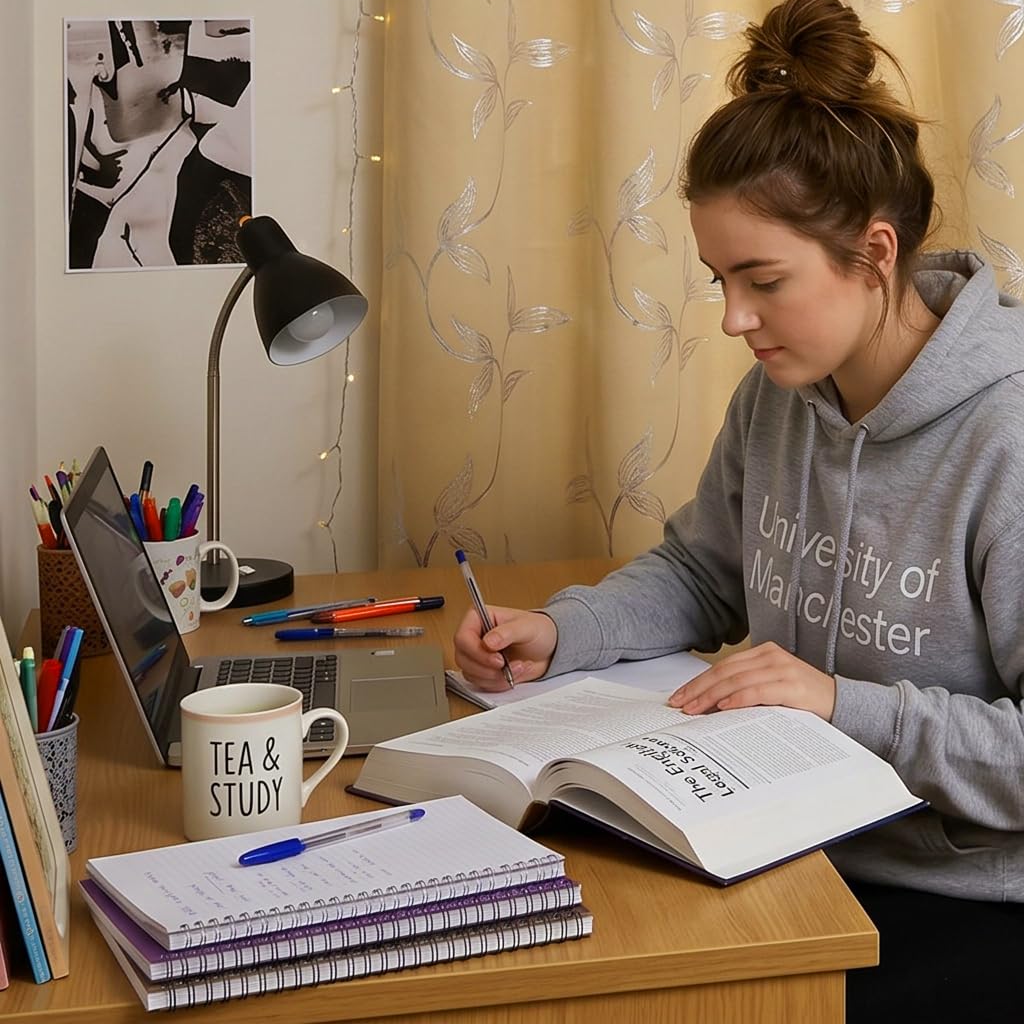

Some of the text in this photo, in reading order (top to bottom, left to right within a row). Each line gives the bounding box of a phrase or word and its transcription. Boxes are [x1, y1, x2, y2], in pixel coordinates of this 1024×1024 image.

[759, 495, 941, 603] Univesity of
[210, 736, 280, 776] TEA &
[210, 776, 283, 817] STUDY
[684, 776, 713, 803] The
